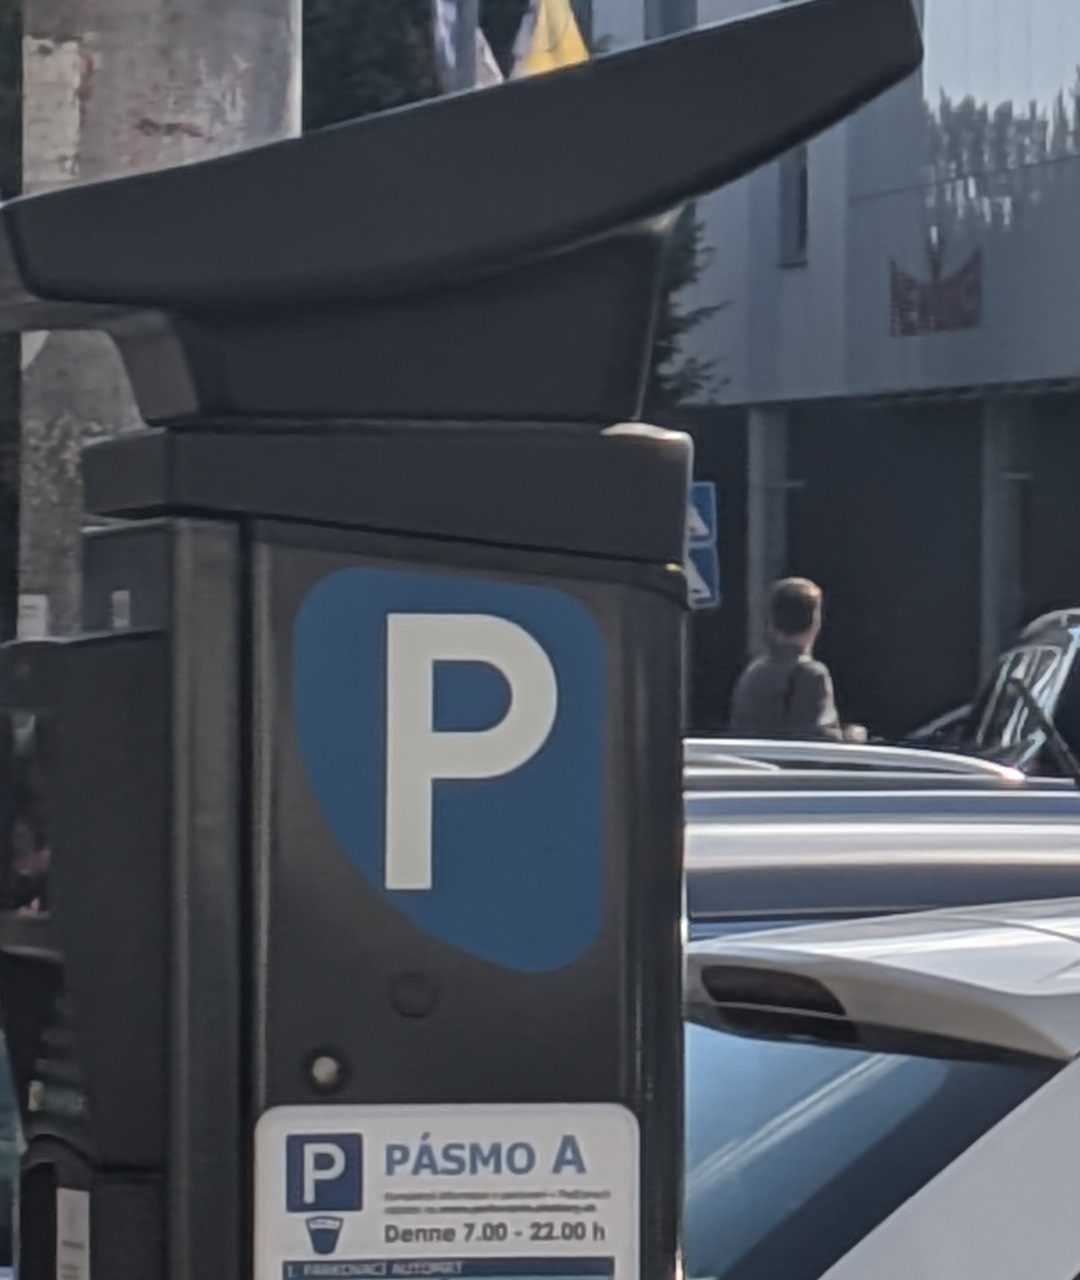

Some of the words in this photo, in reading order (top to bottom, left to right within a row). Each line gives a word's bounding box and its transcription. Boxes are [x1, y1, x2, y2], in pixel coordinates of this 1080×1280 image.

[385, 613, 558, 890] P
[302, 1142, 347, 1205] P
[384, 1132, 537, 1176] PÁSMO
[551, 1134, 588, 1175] A
[384, 1224, 456, 1244] Denne
[463, 1222, 508, 1243] 7.00
[528, 1221, 587, 1242] 22.00
[592, 1222, 606, 1242] h
